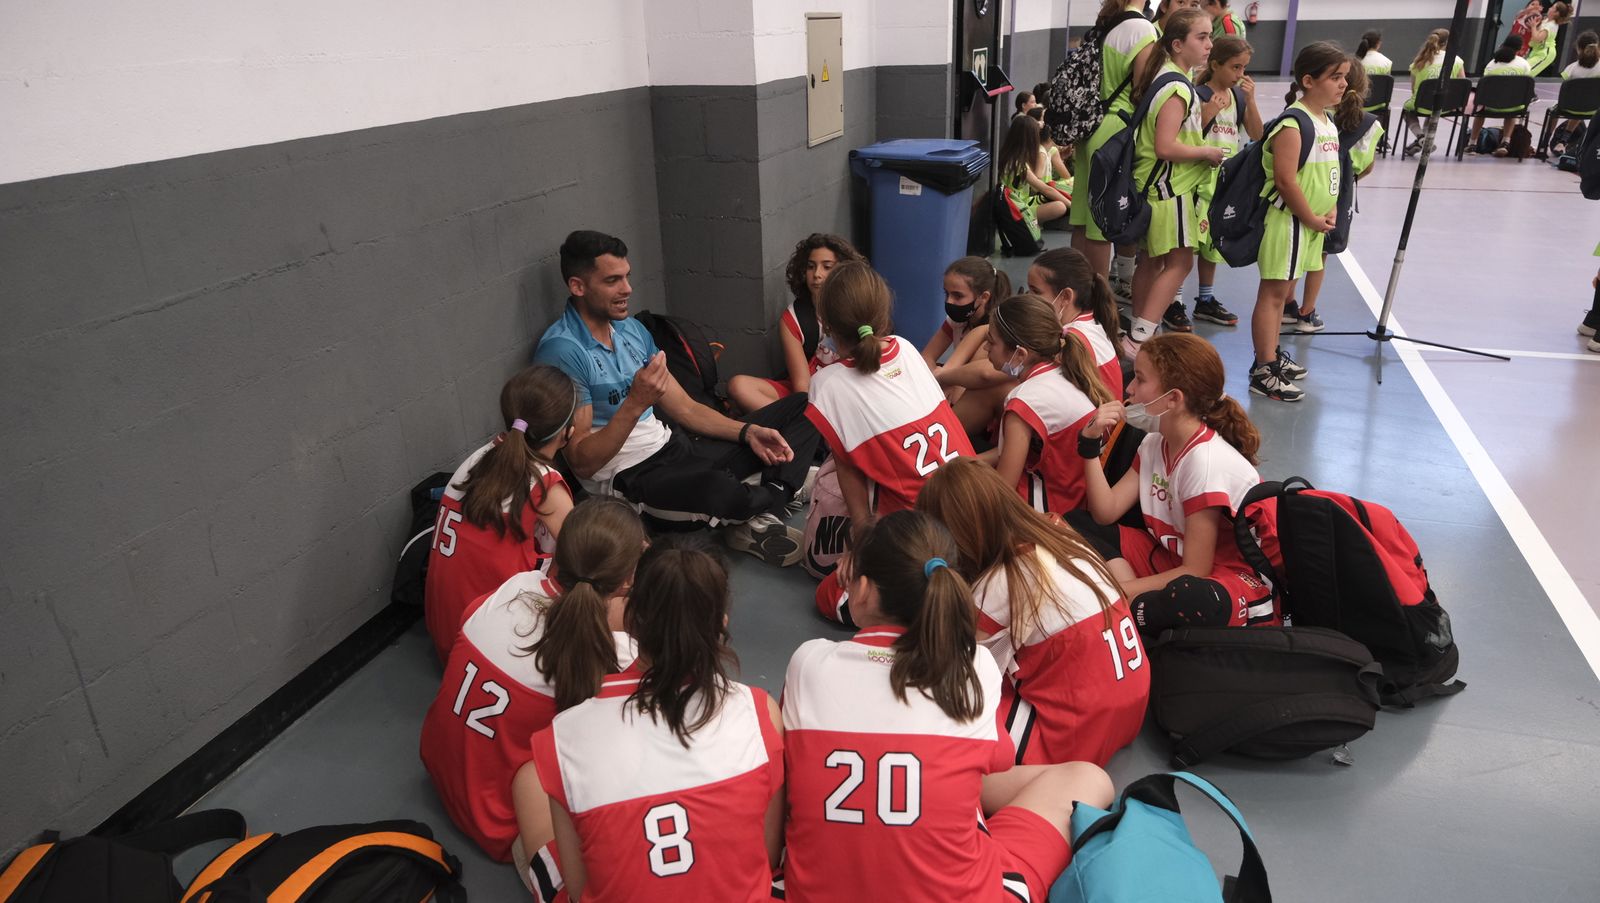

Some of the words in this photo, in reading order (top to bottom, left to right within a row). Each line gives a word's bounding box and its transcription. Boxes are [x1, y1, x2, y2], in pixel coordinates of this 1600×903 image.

[1329, 167, 1339, 196] 8
[902, 422, 960, 477] 22
[432, 504, 463, 558] 15
[813, 515, 851, 556] NIK
[1136, 609, 1146, 626] NBA
[1101, 615, 1143, 681] 19
[452, 660, 511, 740] 12
[824, 749, 921, 826] 20
[643, 801, 695, 878] 8
